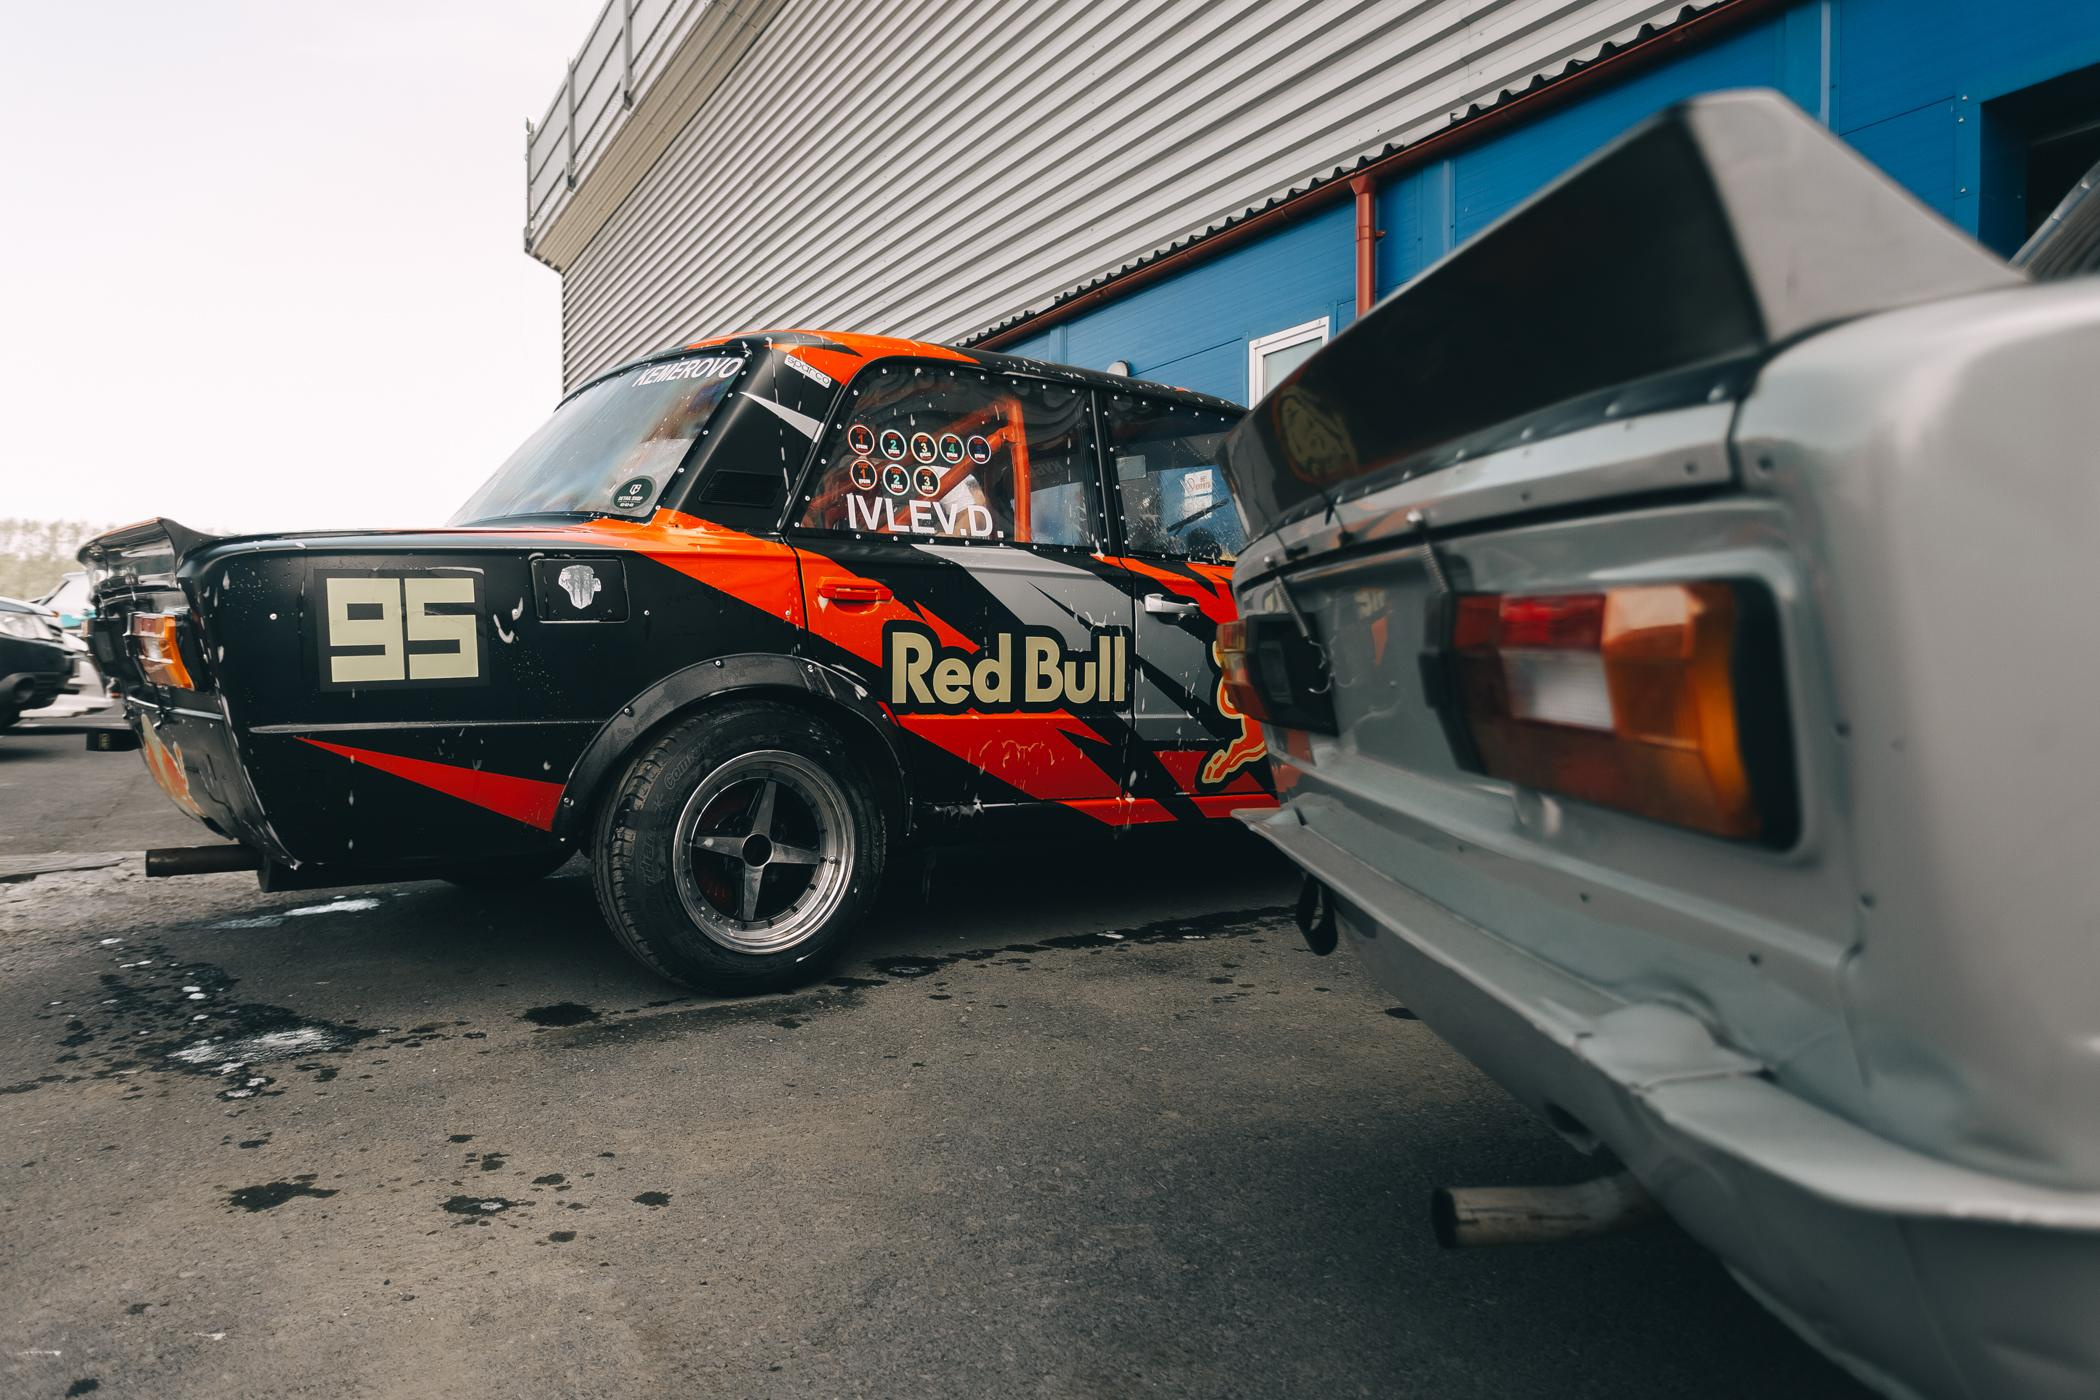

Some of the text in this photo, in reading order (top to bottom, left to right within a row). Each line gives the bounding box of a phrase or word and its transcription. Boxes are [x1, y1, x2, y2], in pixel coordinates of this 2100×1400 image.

[632, 357, 746, 387] KEMEROVO
[787, 356, 831, 386] sparco
[858, 434, 864, 444] 1
[890, 440, 897, 450] 2
[920, 443, 928, 453] 3
[948, 444, 956, 453] 4
[860, 469, 866, 479] 1
[893, 475, 900, 484] 2
[923, 476, 930, 486] 3
[326, 577, 479, 683] 95
[892, 631, 1125, 704] Red Bull
